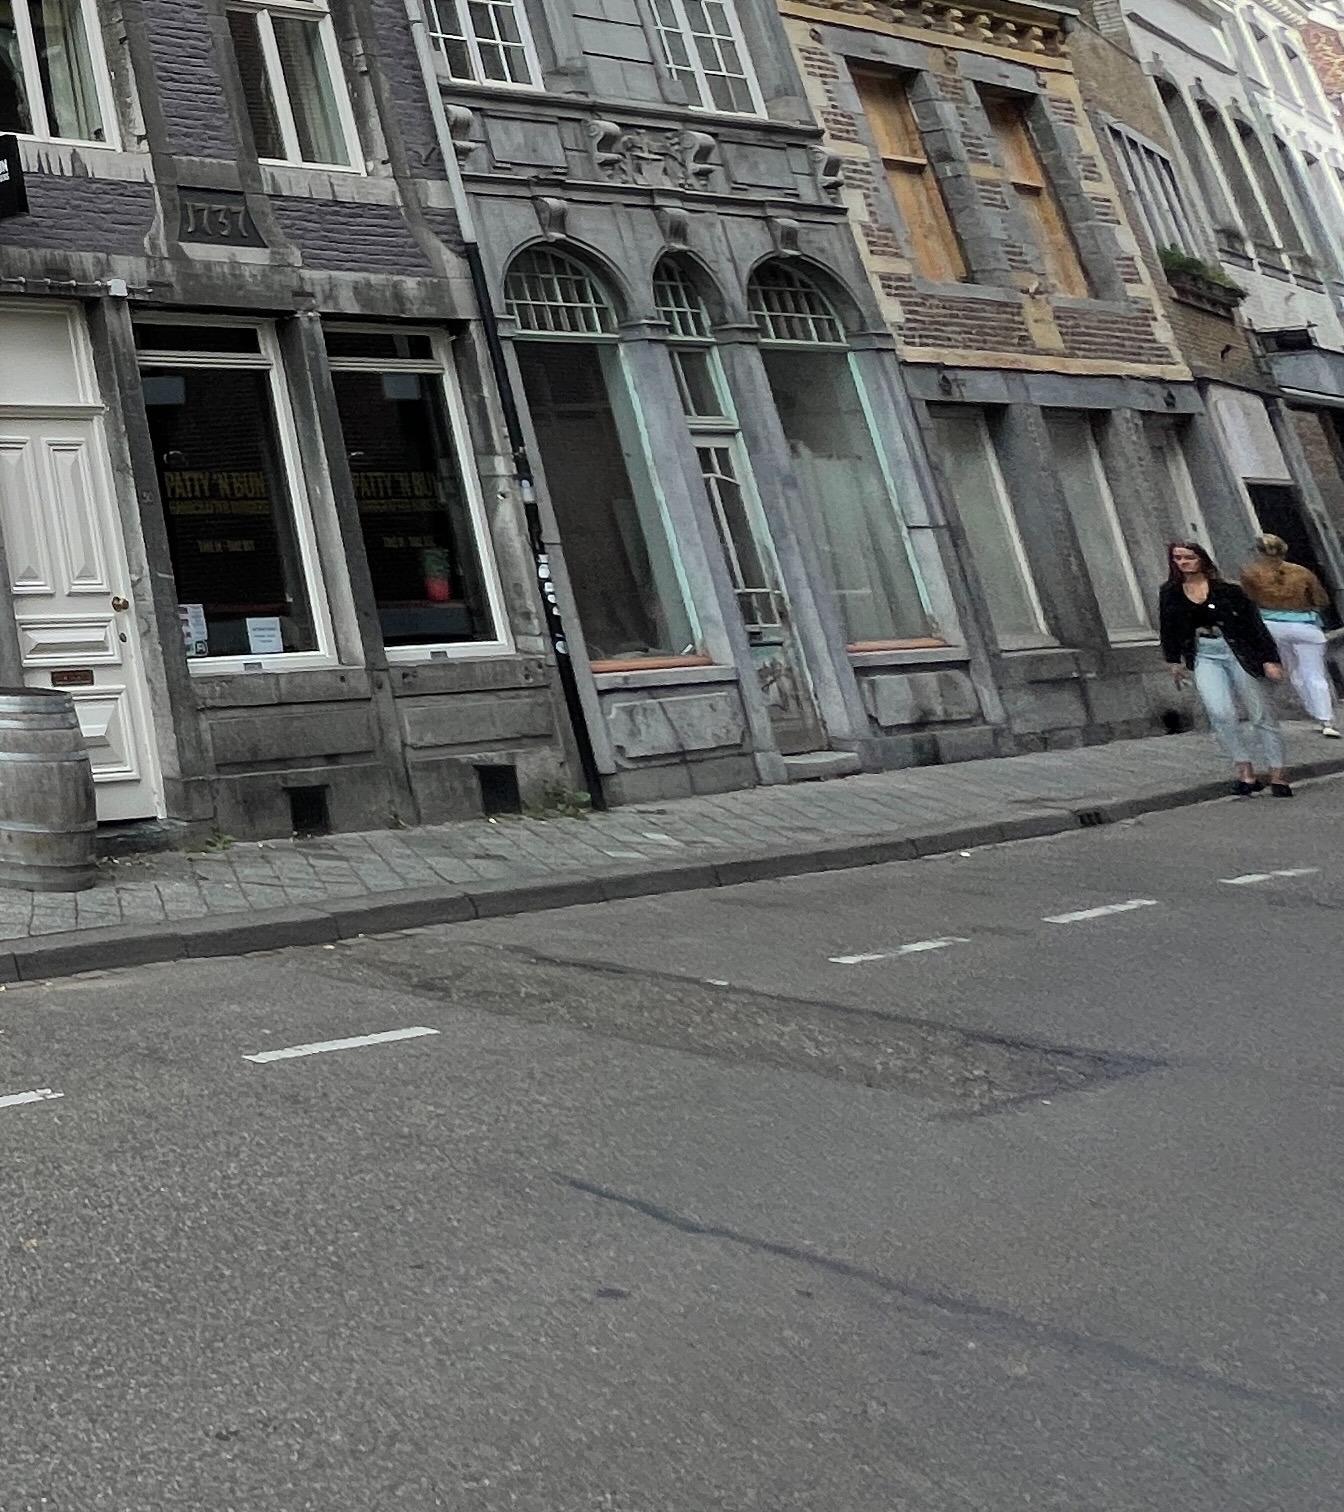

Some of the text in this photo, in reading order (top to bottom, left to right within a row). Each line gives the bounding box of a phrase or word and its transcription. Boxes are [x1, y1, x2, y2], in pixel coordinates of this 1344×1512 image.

[185, 201, 249, 238] 1737
[163, 471, 210, 498] PATTY
[230, 471, 266, 498] BUN
